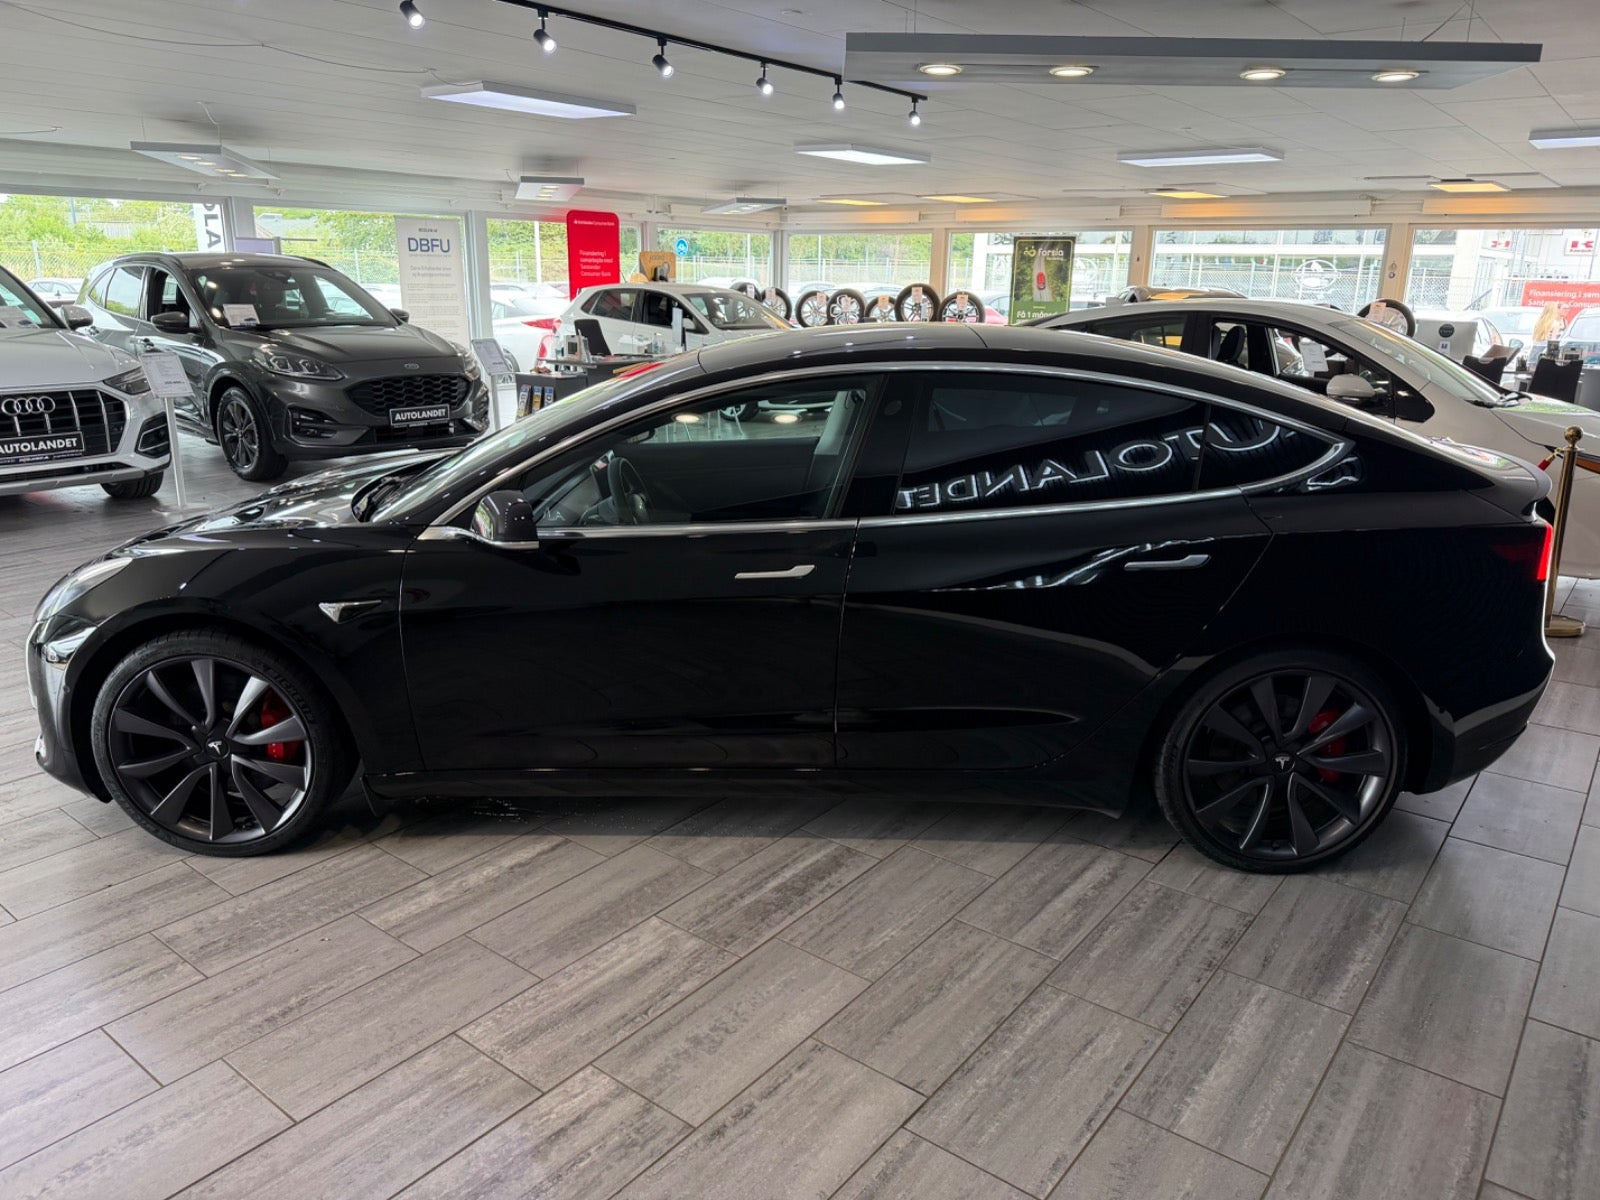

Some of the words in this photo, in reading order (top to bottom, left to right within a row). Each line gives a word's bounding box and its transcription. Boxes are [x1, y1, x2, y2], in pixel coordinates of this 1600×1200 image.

[407, 237, 450, 253] DBFU
[1529, 289, 1577, 299] Finansiering
[1016, 310, 1026, 318] Få
[394, 409, 446, 421] AUTOLANDET
